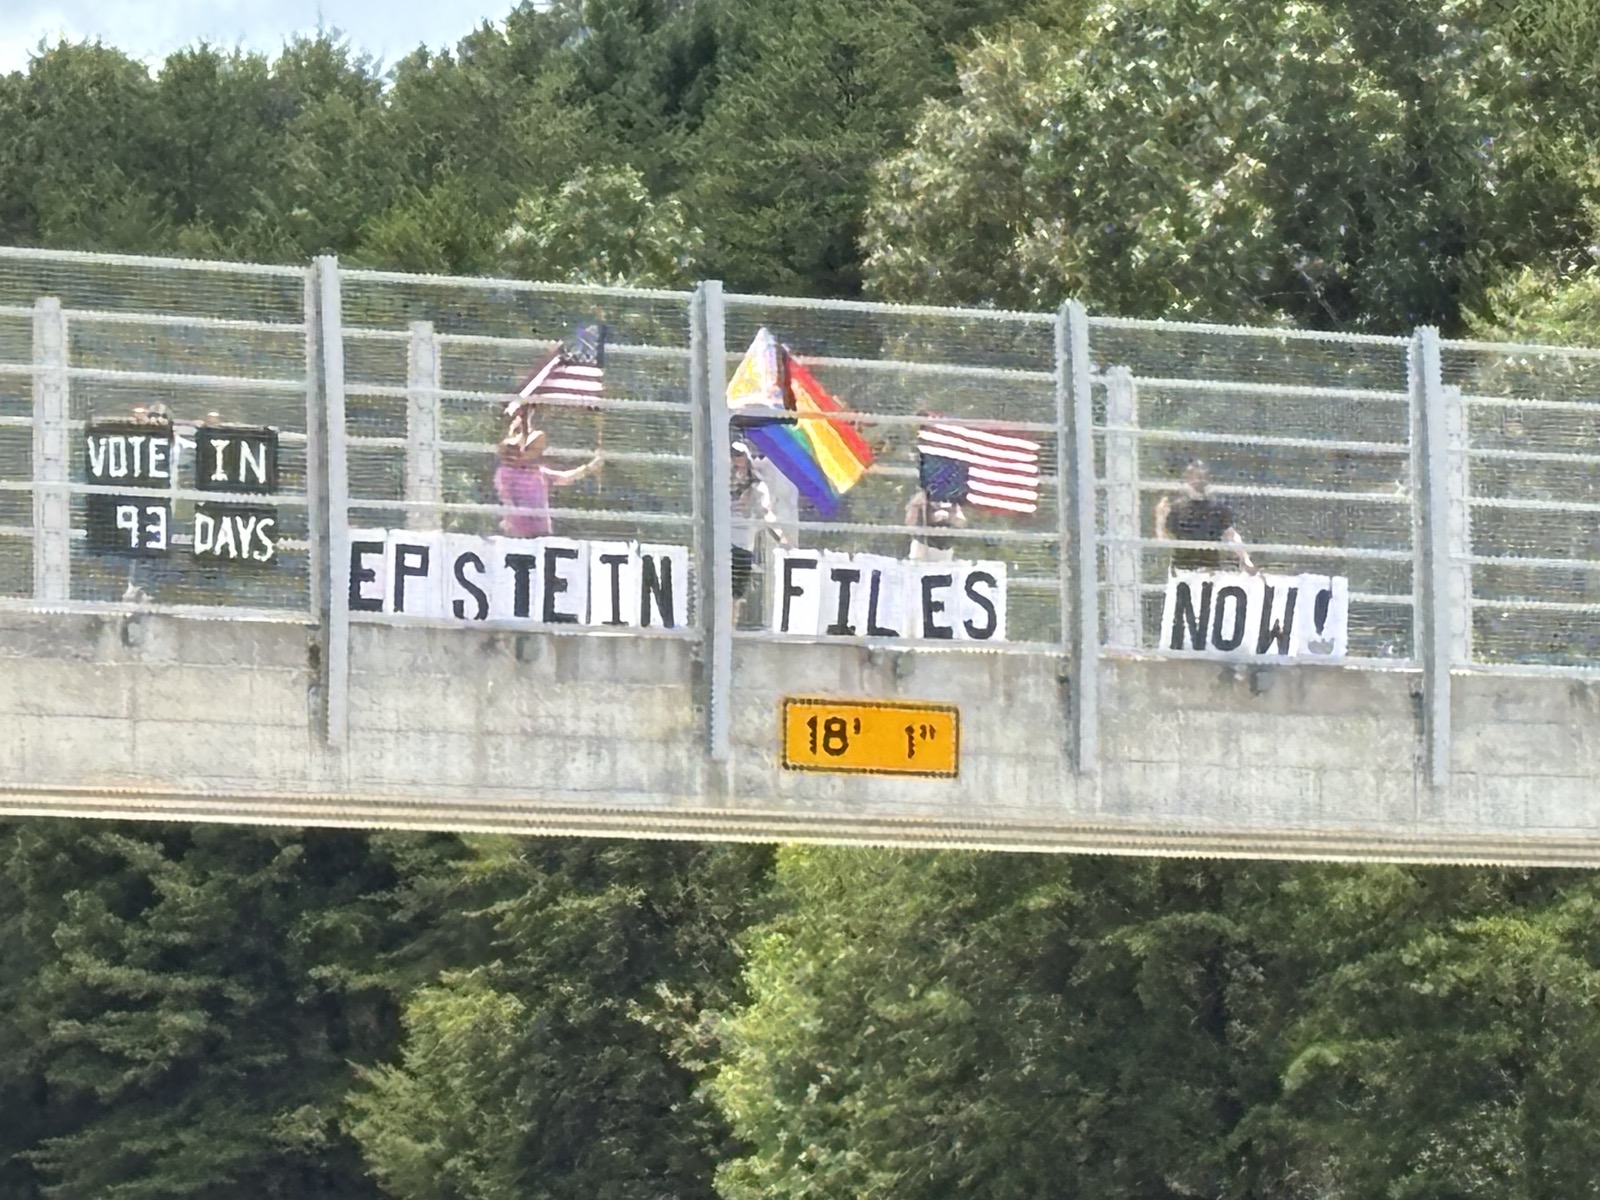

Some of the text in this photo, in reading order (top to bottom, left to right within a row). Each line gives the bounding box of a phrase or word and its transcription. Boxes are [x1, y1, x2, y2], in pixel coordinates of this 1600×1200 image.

[87, 436, 267, 484] VOTE IN
[116, 505, 275, 562] 93 DAYS
[348, 541, 1335, 655] EPSTEIN FILES NOW!
[807, 715, 861, 756] 18'
